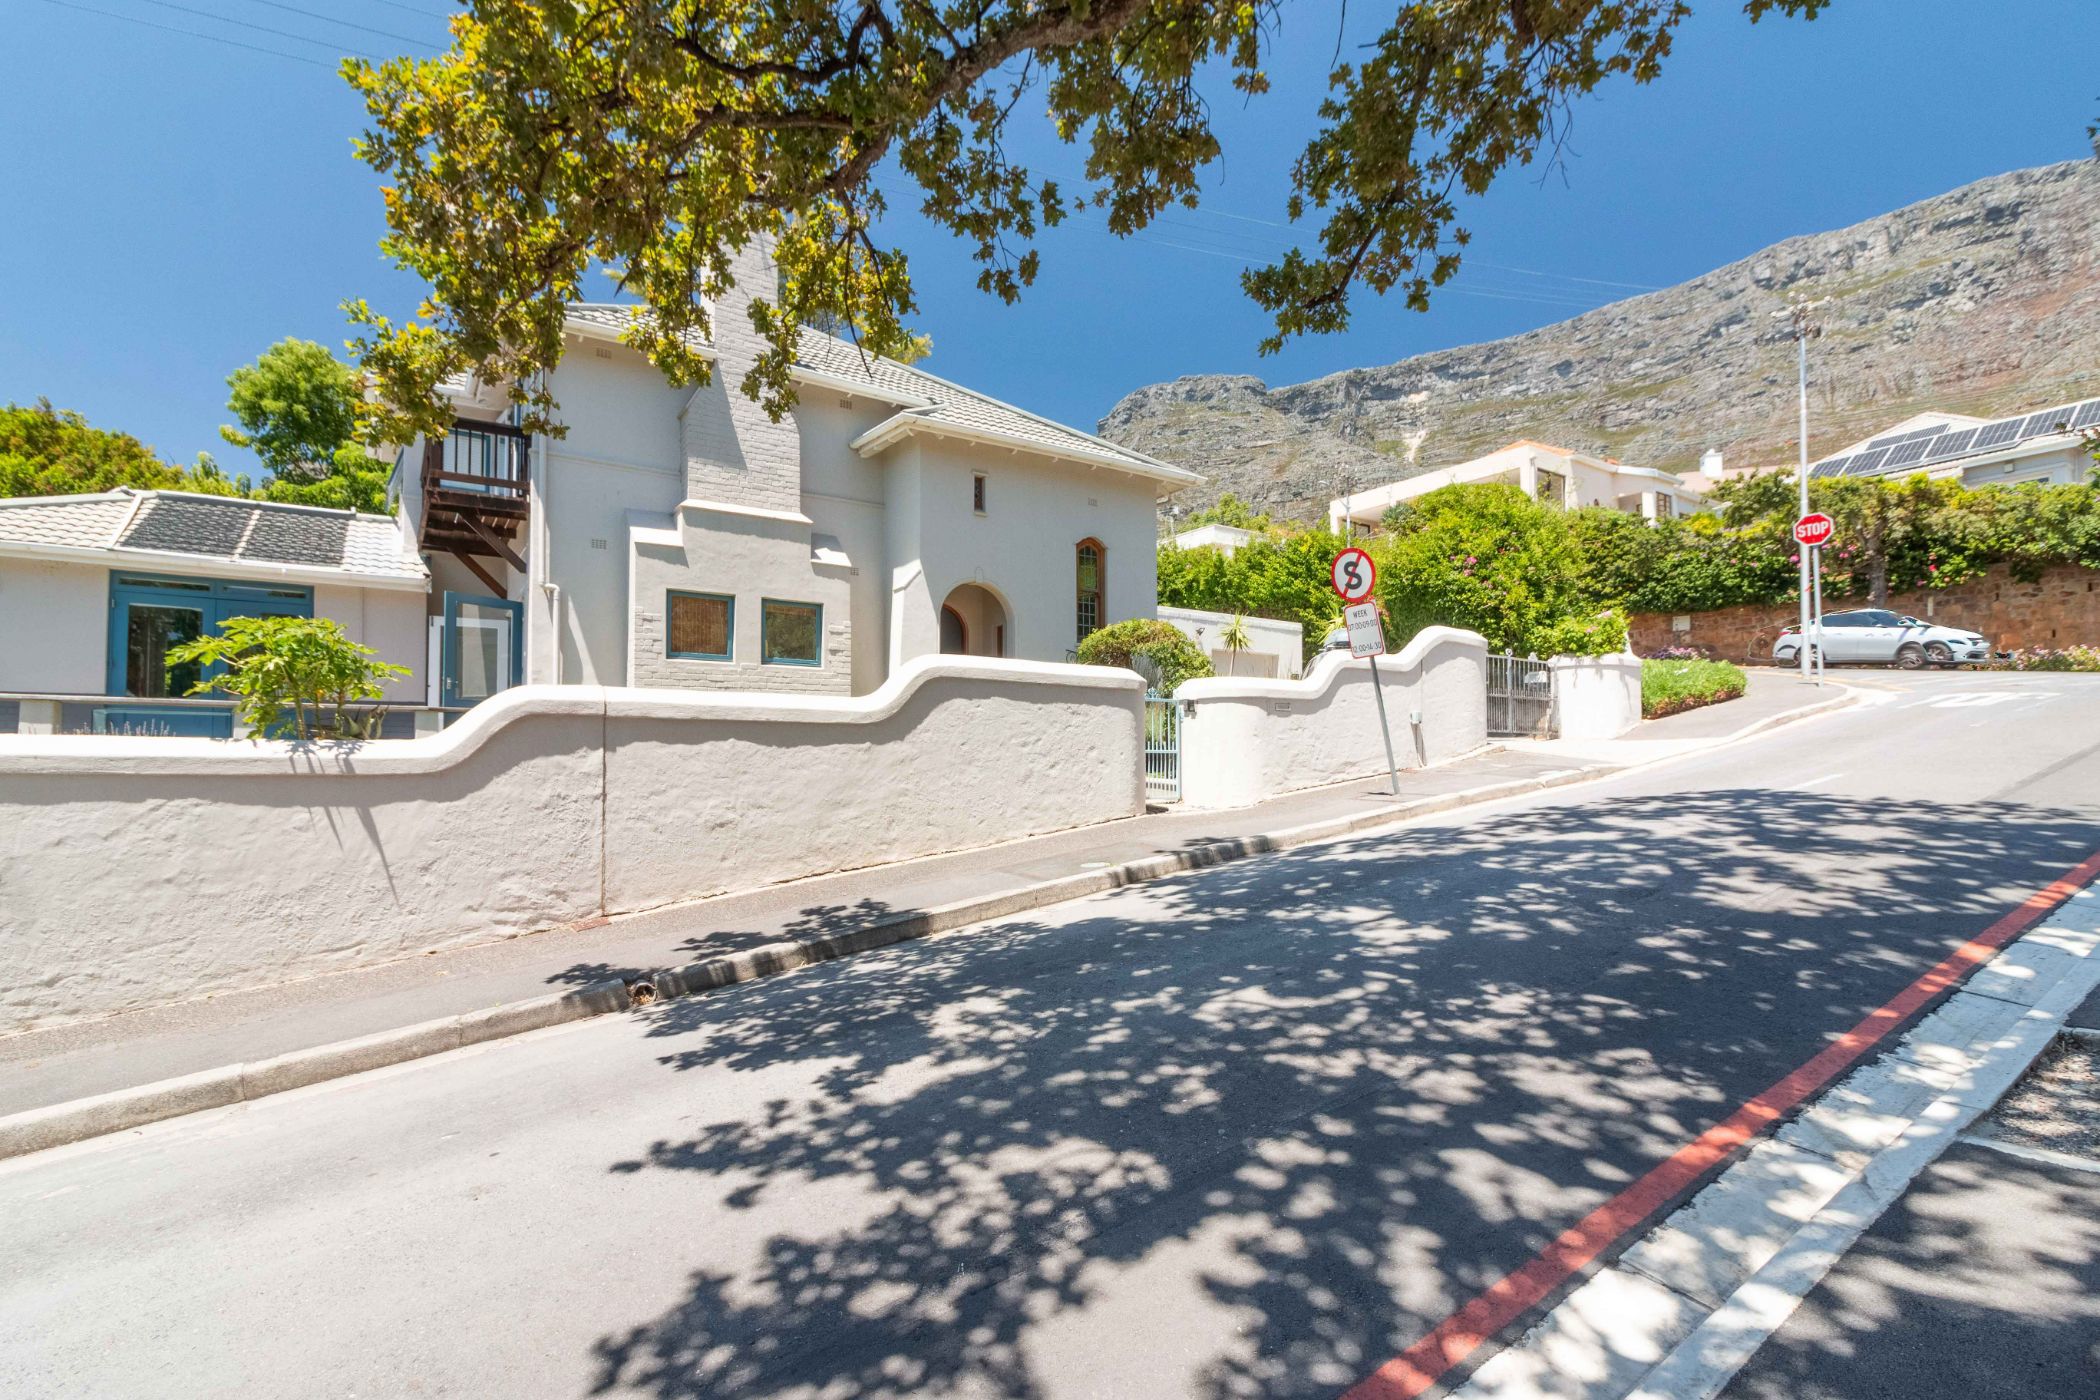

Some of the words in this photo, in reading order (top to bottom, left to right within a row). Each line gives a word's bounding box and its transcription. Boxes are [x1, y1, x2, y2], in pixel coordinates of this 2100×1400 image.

[1797, 521, 1829, 538] STOP
[1343, 561, 1363, 590] S
[1353, 609, 1368, 618] WEEK
